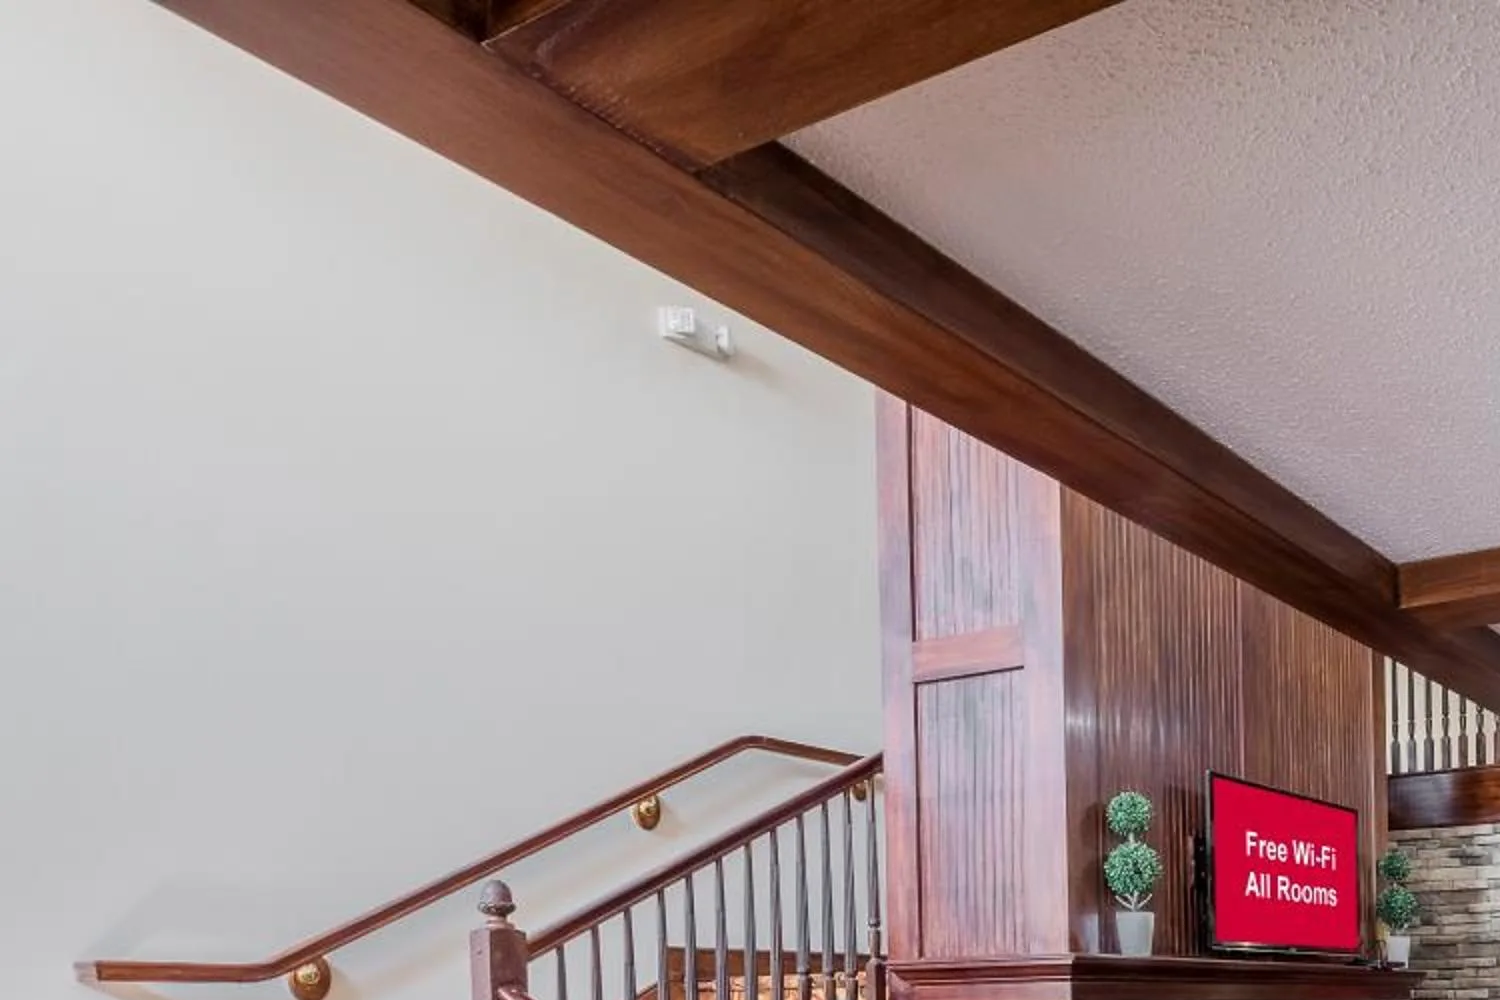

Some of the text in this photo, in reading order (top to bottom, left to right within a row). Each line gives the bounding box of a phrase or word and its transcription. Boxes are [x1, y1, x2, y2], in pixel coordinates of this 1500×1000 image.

[1245, 831, 1337, 870] Free Wi-Fi
[1245, 871, 1338, 907] All Rooms
